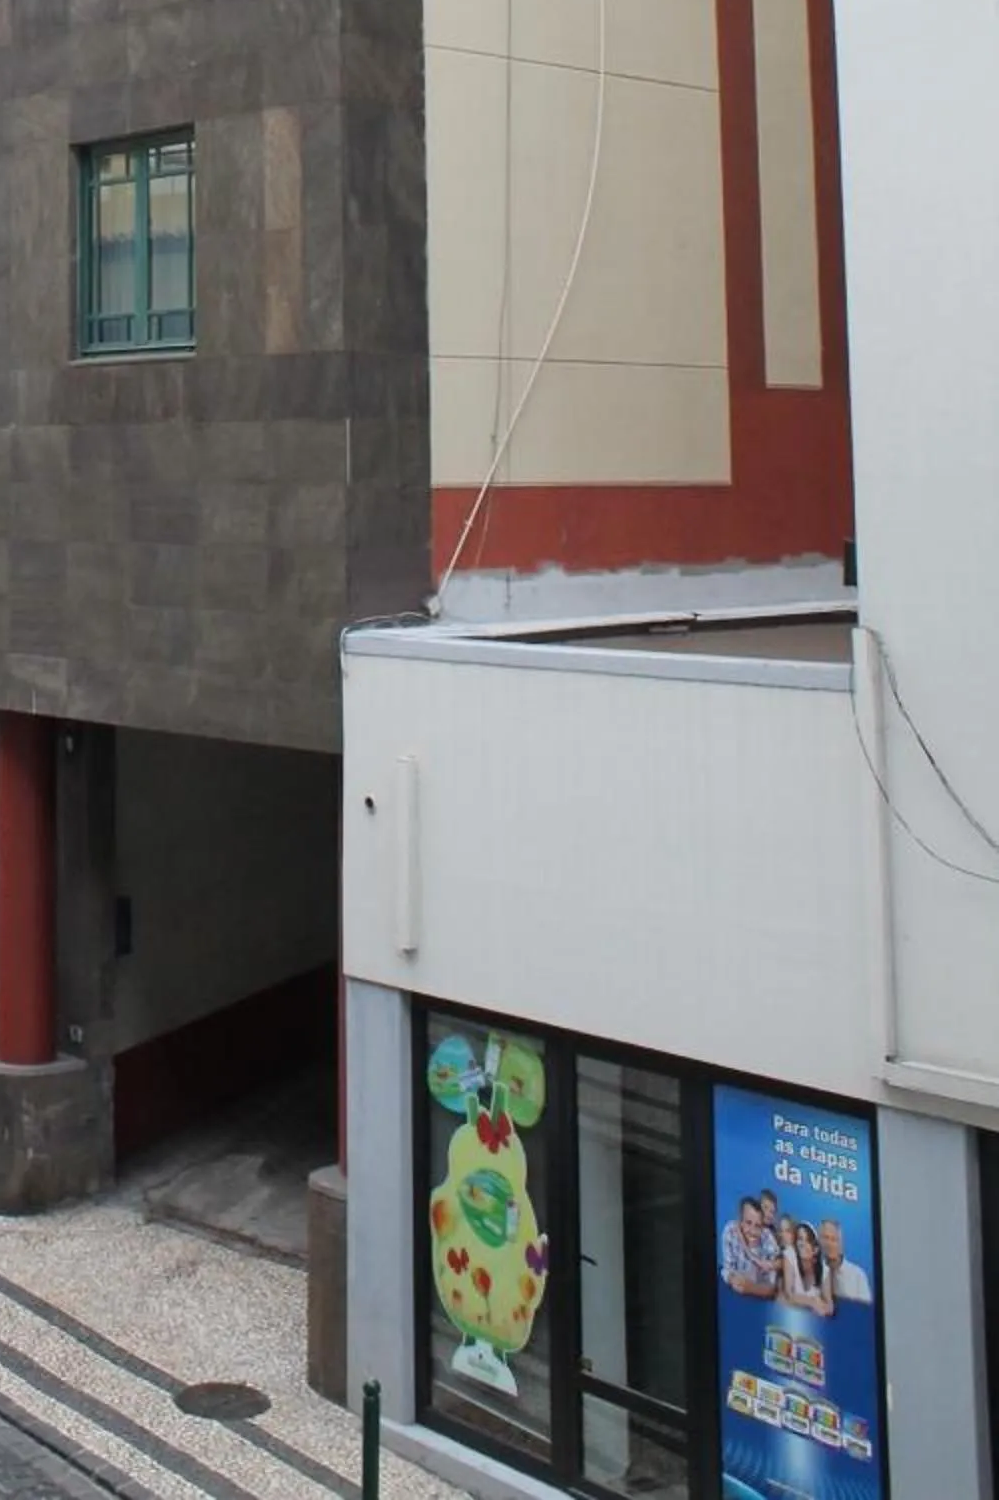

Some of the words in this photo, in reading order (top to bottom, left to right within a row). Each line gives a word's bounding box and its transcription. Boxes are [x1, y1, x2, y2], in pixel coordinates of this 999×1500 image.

[773, 1114, 808, 1137] Para
[814, 1126, 857, 1151] todas
[775, 1139, 794, 1155] as
[800, 1145, 857, 1171] etapas
[774, 1159, 802, 1185] da
[809, 1170, 858, 1201] vida
